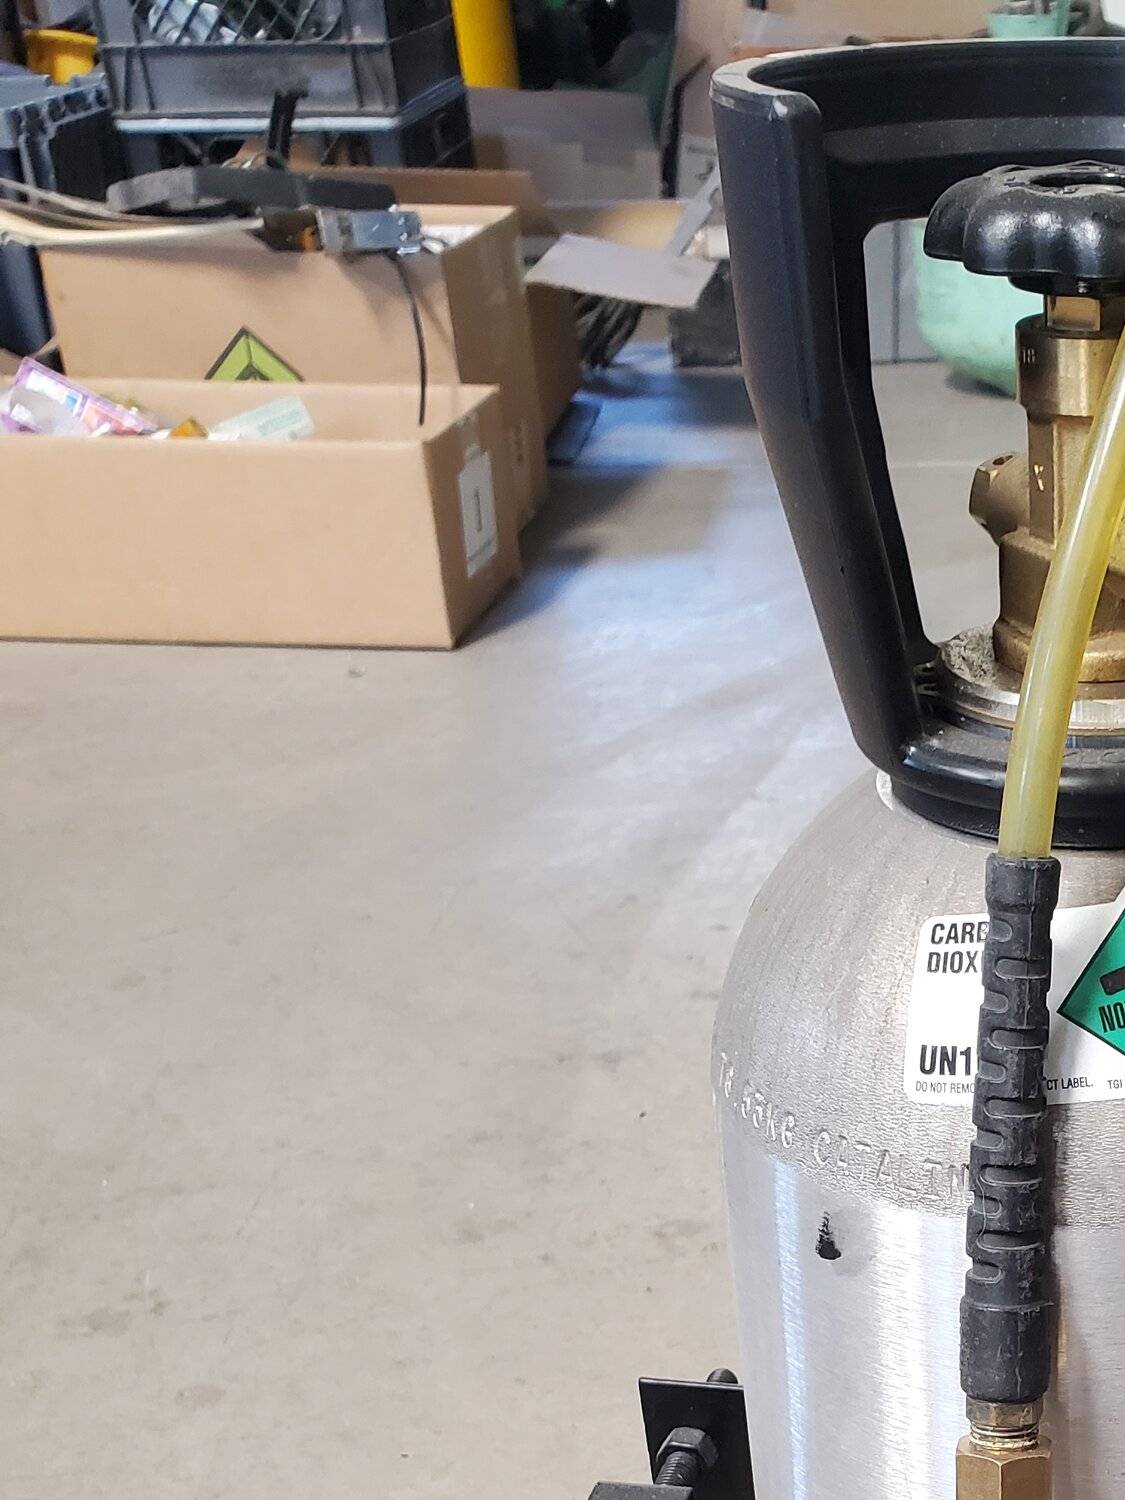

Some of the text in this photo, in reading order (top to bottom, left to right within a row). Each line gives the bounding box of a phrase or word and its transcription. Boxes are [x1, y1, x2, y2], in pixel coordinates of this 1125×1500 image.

[930, 920, 990, 945] CARB
[927, 949, 979, 974] DIOX
[919, 1044, 972, 1076] UN1
[916, 1080, 928, 1093] DO
[930, 1081, 948, 1093] NOT
[950, 1082, 975, 1094] REMO
[1061, 1076, 1094, 1090] LABEL.
[1107, 1079, 1123, 1090] TGI
[813, 1130, 973, 1200] CATALIN
